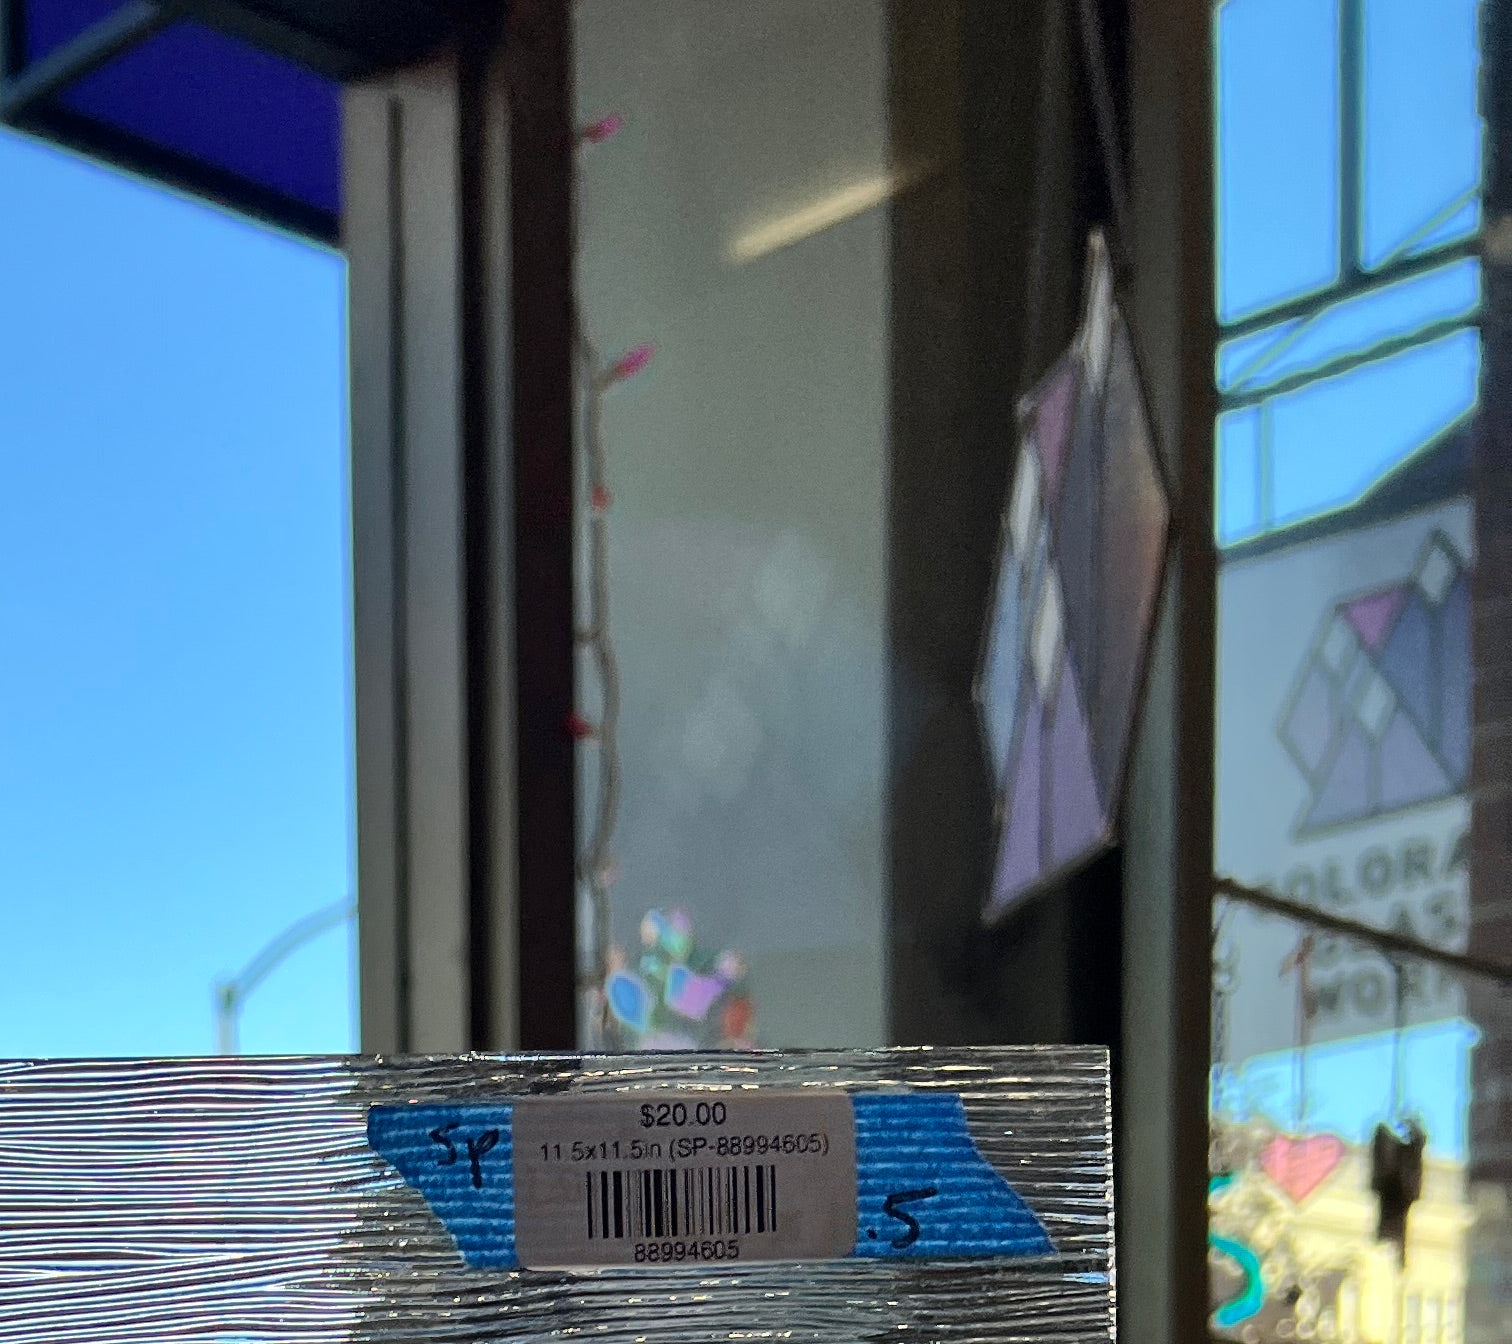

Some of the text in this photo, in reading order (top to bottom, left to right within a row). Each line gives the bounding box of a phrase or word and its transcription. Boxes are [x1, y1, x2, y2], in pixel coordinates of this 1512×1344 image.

[639, 1102, 727, 1128] $20.00
[541, 1139, 662, 1161] 115x11.5in
[634, 1240, 740, 1263] 88994605
